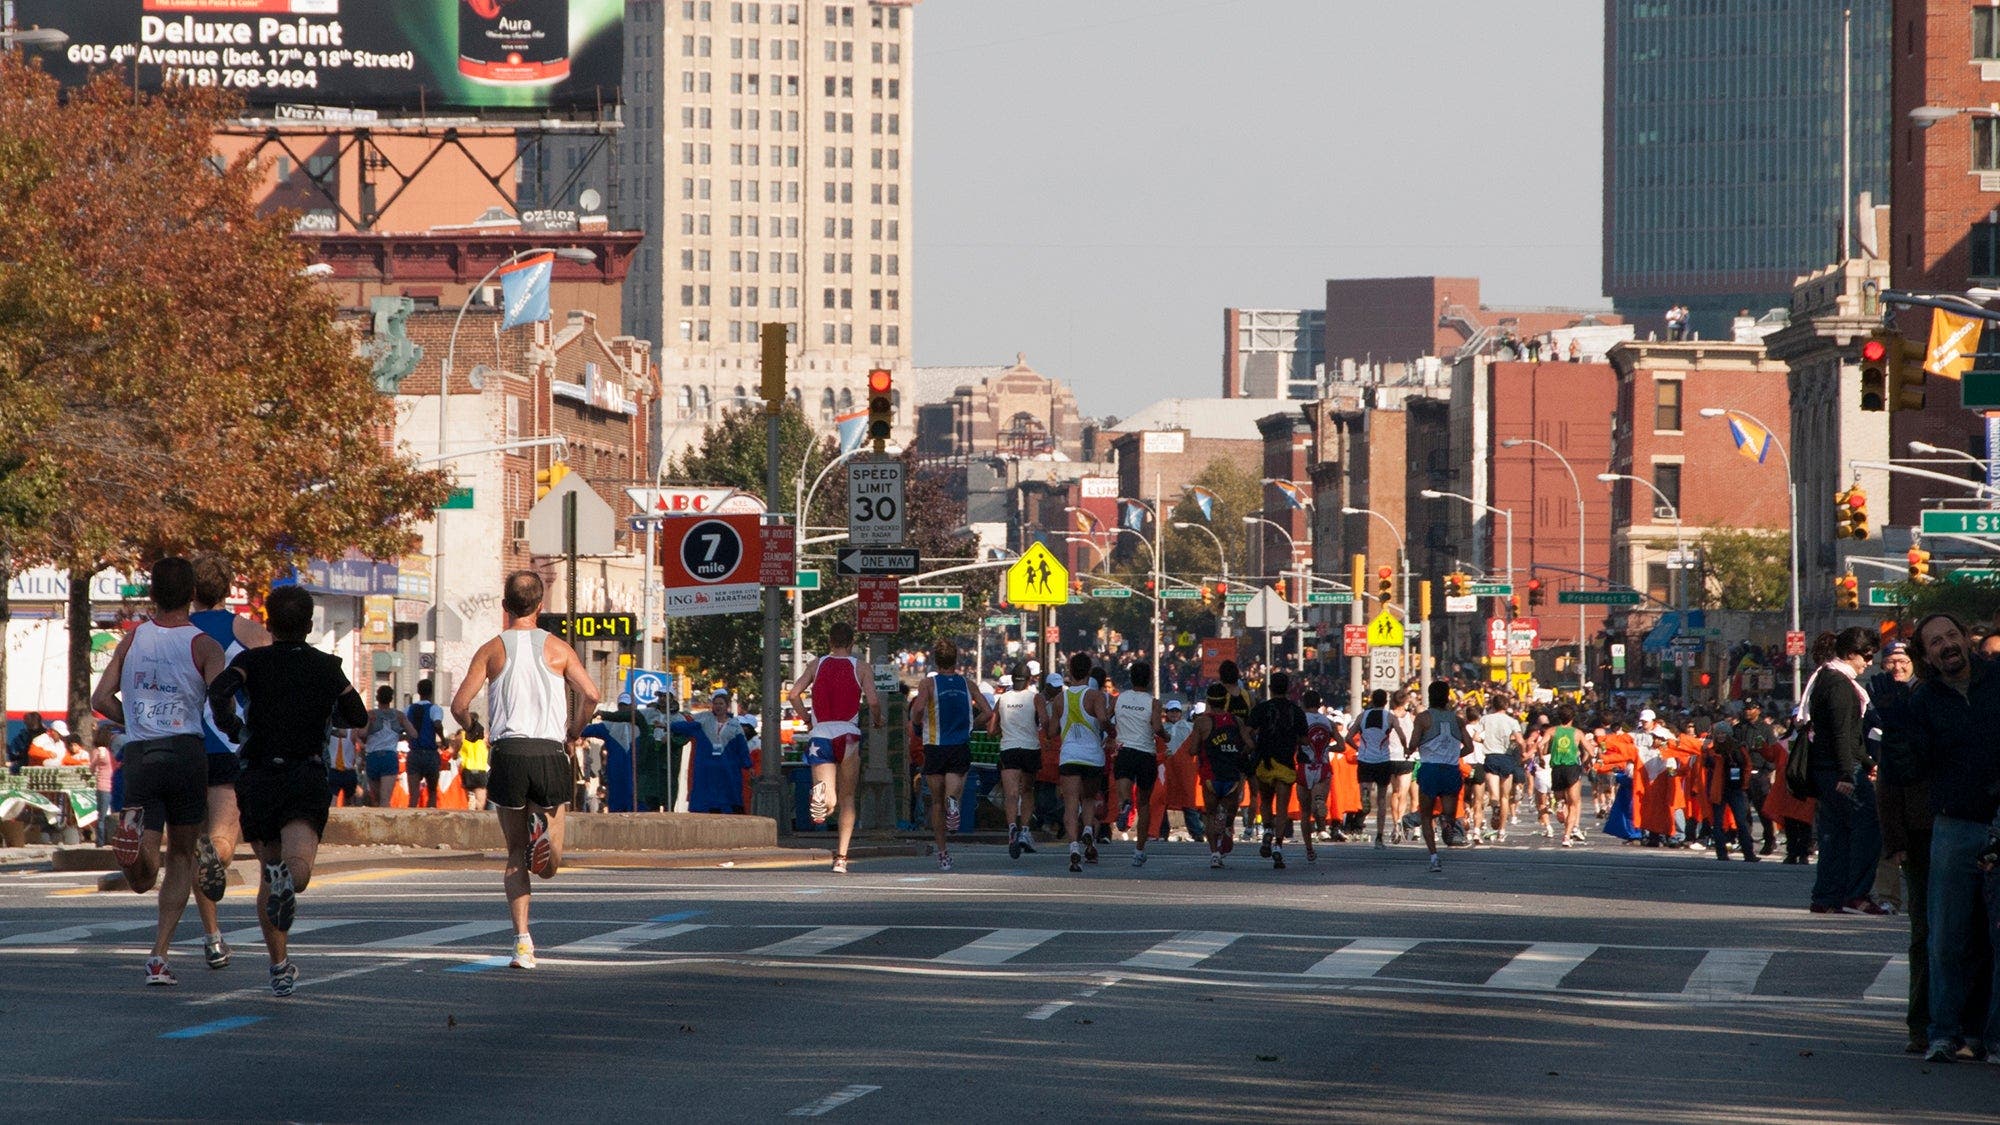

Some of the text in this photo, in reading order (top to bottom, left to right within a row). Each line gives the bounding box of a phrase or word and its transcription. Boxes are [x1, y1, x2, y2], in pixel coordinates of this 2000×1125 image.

[141, 15, 342, 45] Deluxe Paint
[499, 16, 531, 31] Aura
[67, 43, 414, 70] 605 4th Avenue (bet. 17th & 18th Street)
[166, 67, 317, 88] (718) 768-9494
[853, 469, 898, 480] SPEED
[858, 483, 892, 493] LIMIT
[655, 495, 709, 512] ABC
[855, 496, 896, 521] 30
[1961, 516, 2000, 531] 1 St
[773, 530, 792, 538] ROUTE
[701, 533, 721, 561] 7
[763, 552, 792, 561] STANDING
[861, 556, 912, 567] ONE WAY
[697, 562, 726, 574] mile
[669, 593, 693, 606] ING
[715, 594, 757, 602] MARATHON
[935, 598, 948, 607] St
[1567, 594, 1618, 602] President
[1374, 665, 1396, 678] 30
